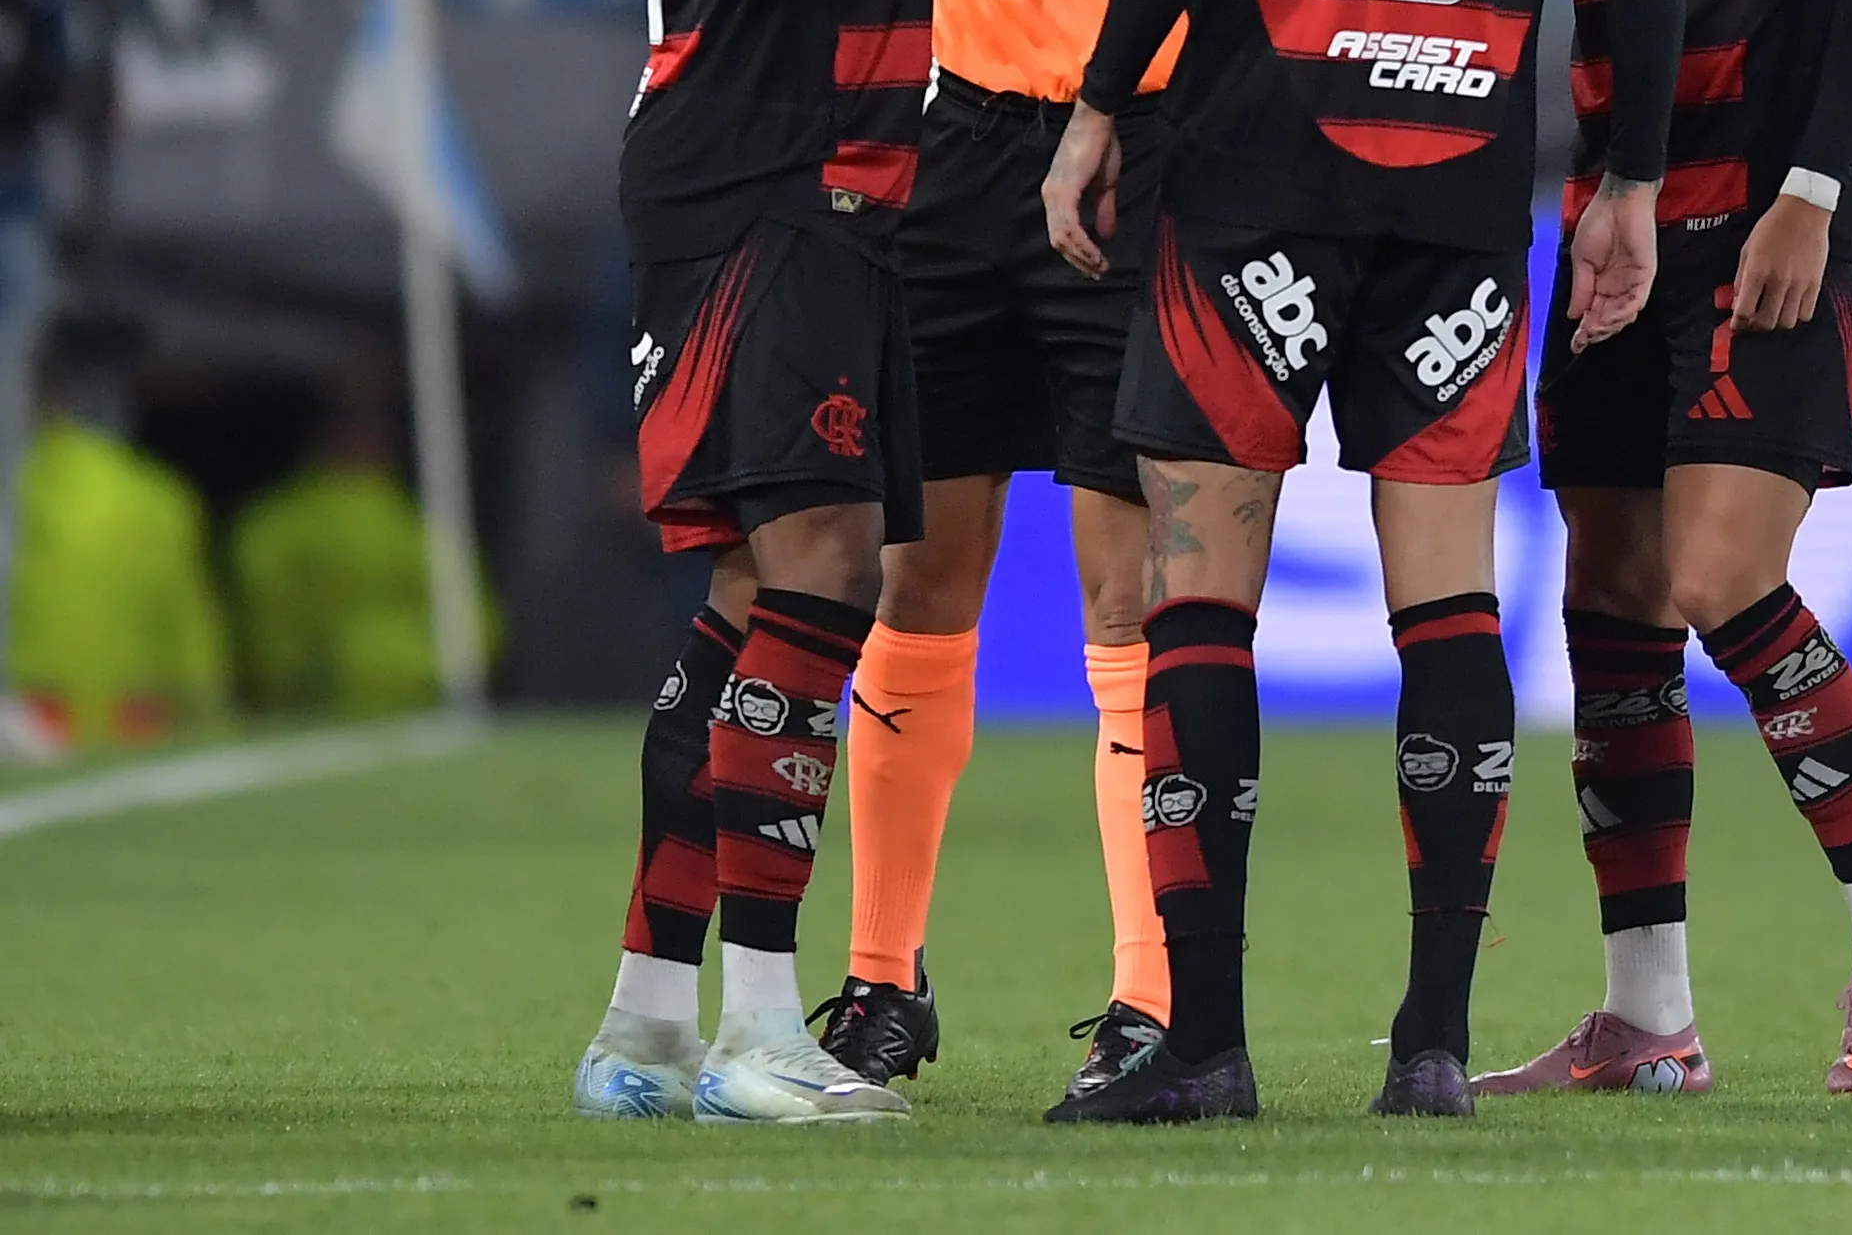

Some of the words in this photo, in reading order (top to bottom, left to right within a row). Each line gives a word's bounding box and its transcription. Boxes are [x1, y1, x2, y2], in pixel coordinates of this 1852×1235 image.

[1327, 30, 1488, 68] ASSIST
[1369, 61, 1497, 98] CARD
[1220, 273, 1241, 298] da
[1234, 296, 1290, 382] construção
[1241, 250, 1328, 371] abc
[1404, 276, 1510, 387] abc
[1436, 382, 1459, 402] da
[1767, 638, 1834, 691] Zé
